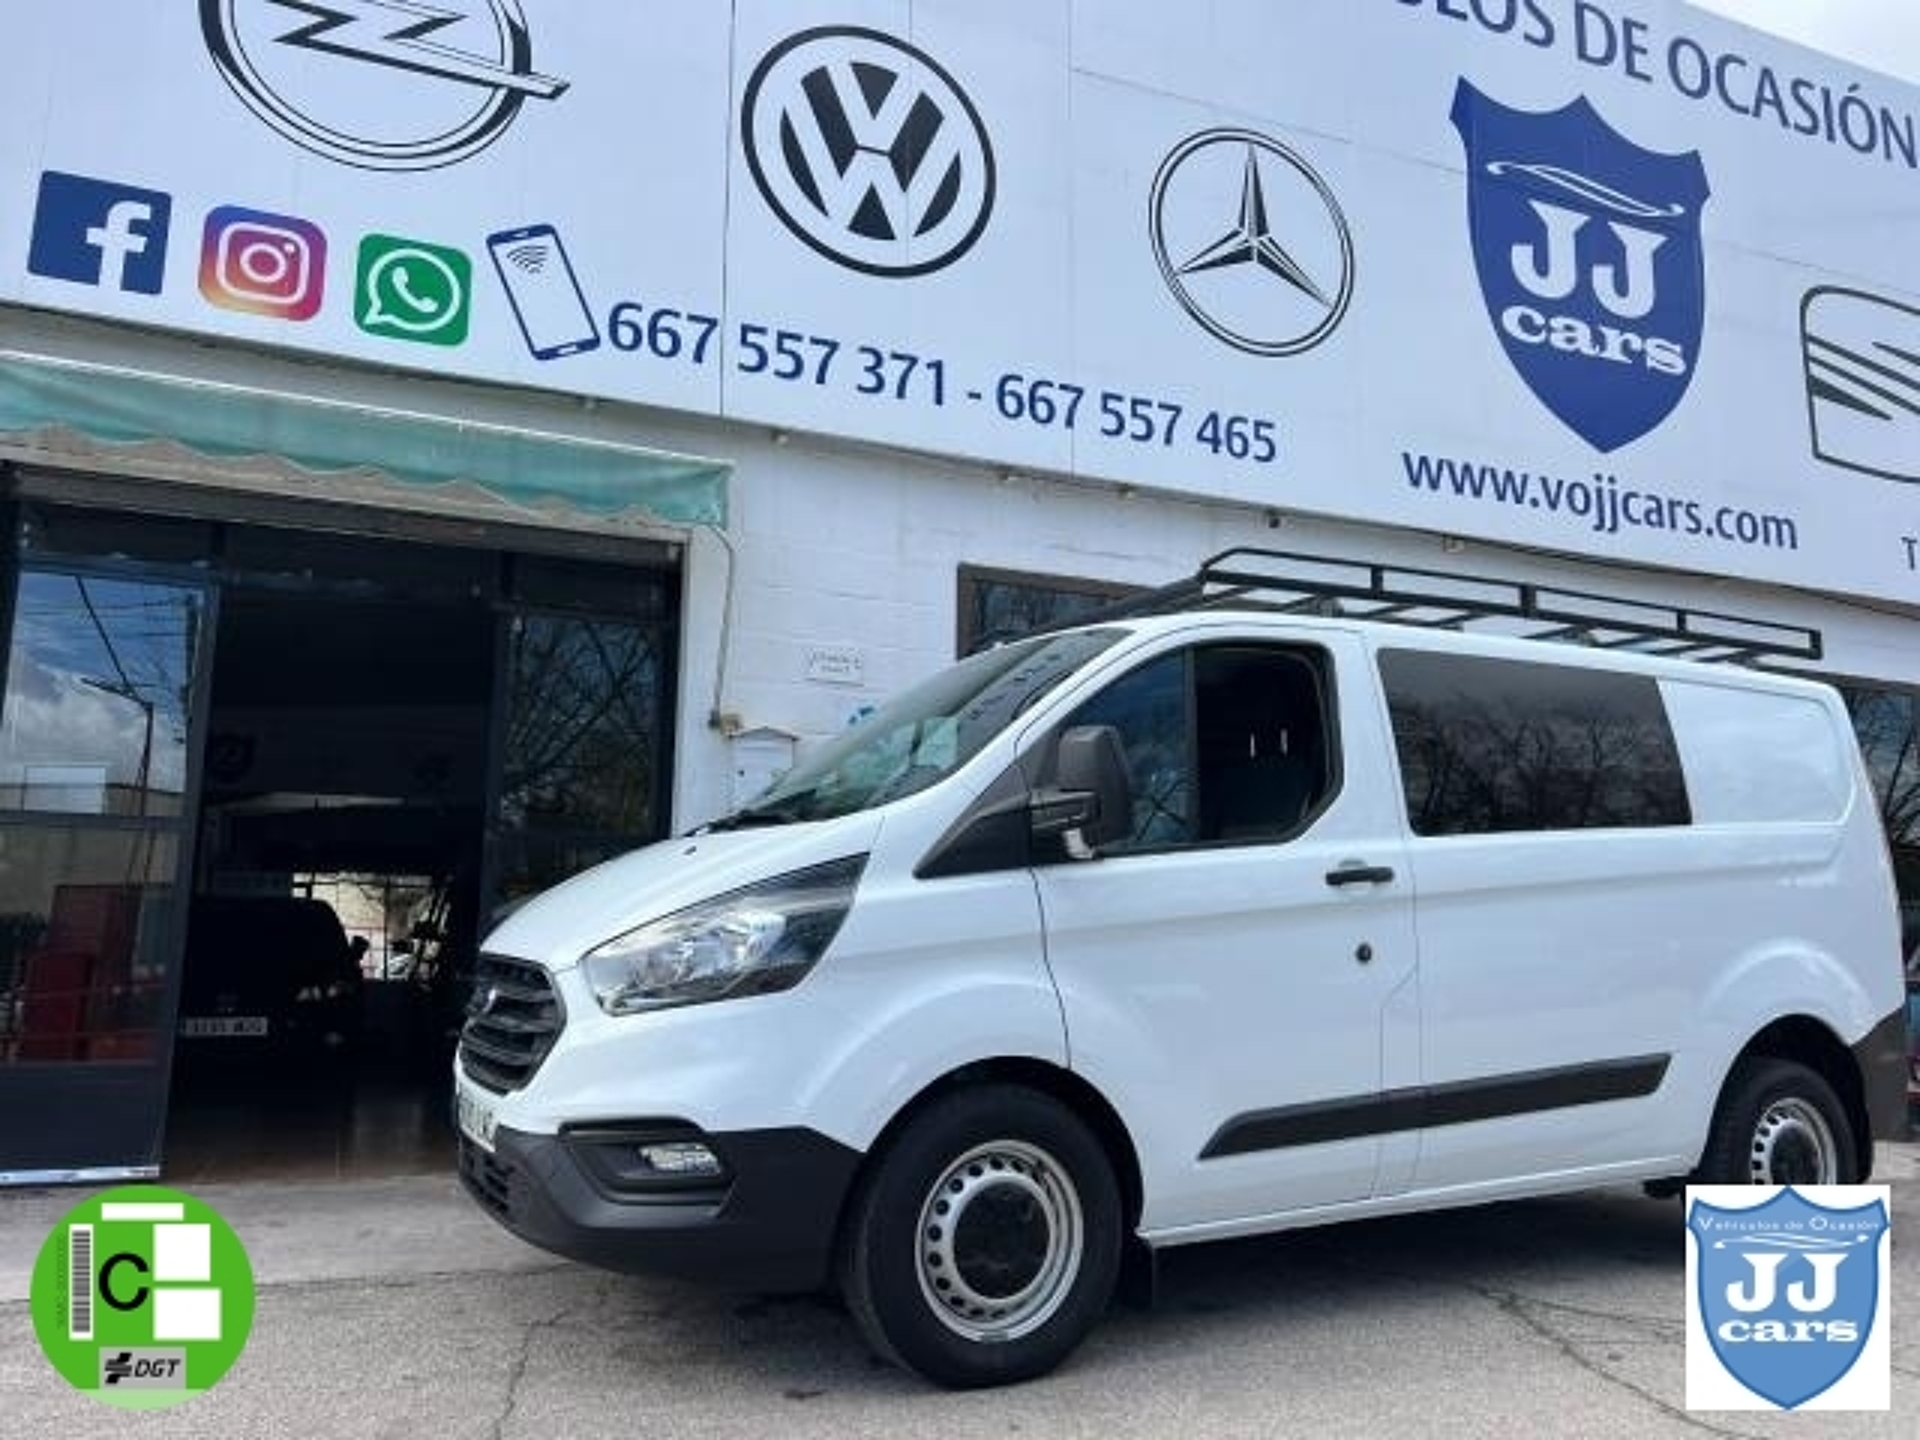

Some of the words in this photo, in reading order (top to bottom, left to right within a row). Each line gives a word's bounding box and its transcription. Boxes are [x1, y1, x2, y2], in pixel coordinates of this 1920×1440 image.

[1574, 1, 1652, 82] DE
[1667, 36, 1918, 169] OCASIÓN
[1511, 199, 1668, 318] JJ
[607, 301, 719, 365] 667
[736, 323, 840, 386] 557
[855, 345, 946, 407] 371
[996, 373, 1085, 430] 667
[1099, 391, 1183, 447] 557
[1195, 409, 1278, 464] 465
[1501, 305, 1687, 375] cars
[1402, 451, 1799, 550] www.vojjcars.com
